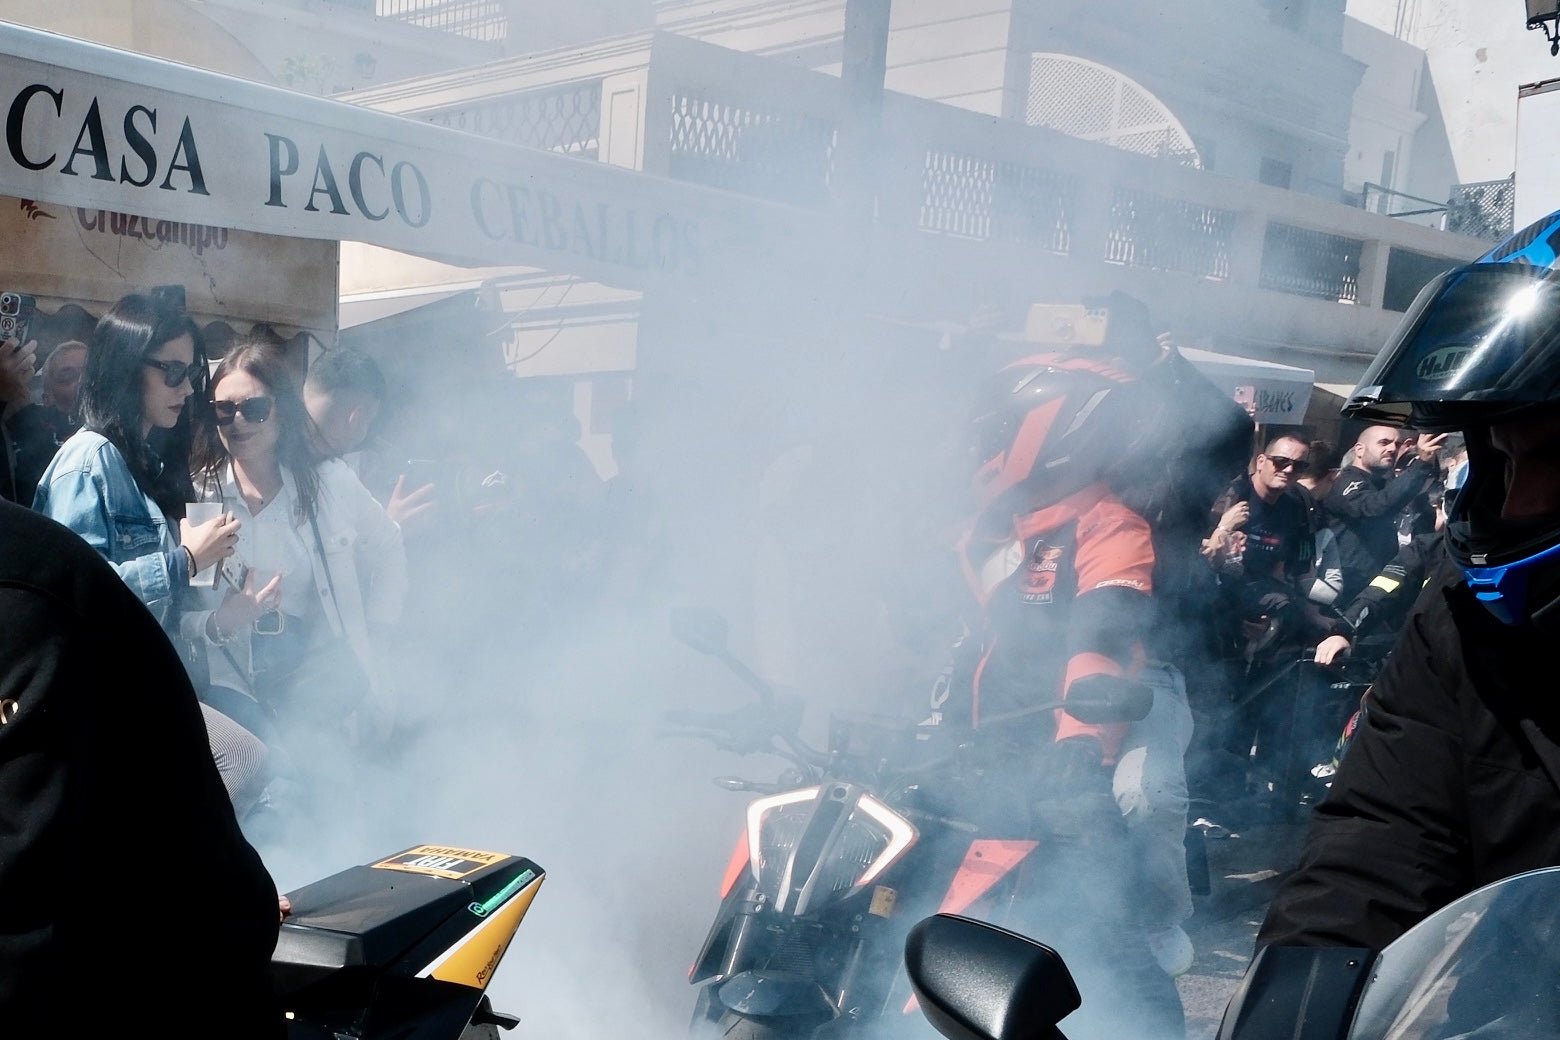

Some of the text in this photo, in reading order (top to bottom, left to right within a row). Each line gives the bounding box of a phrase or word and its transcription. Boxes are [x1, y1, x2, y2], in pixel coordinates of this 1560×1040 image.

[5, 83, 704, 276] CASA PACO CEBALLOS
